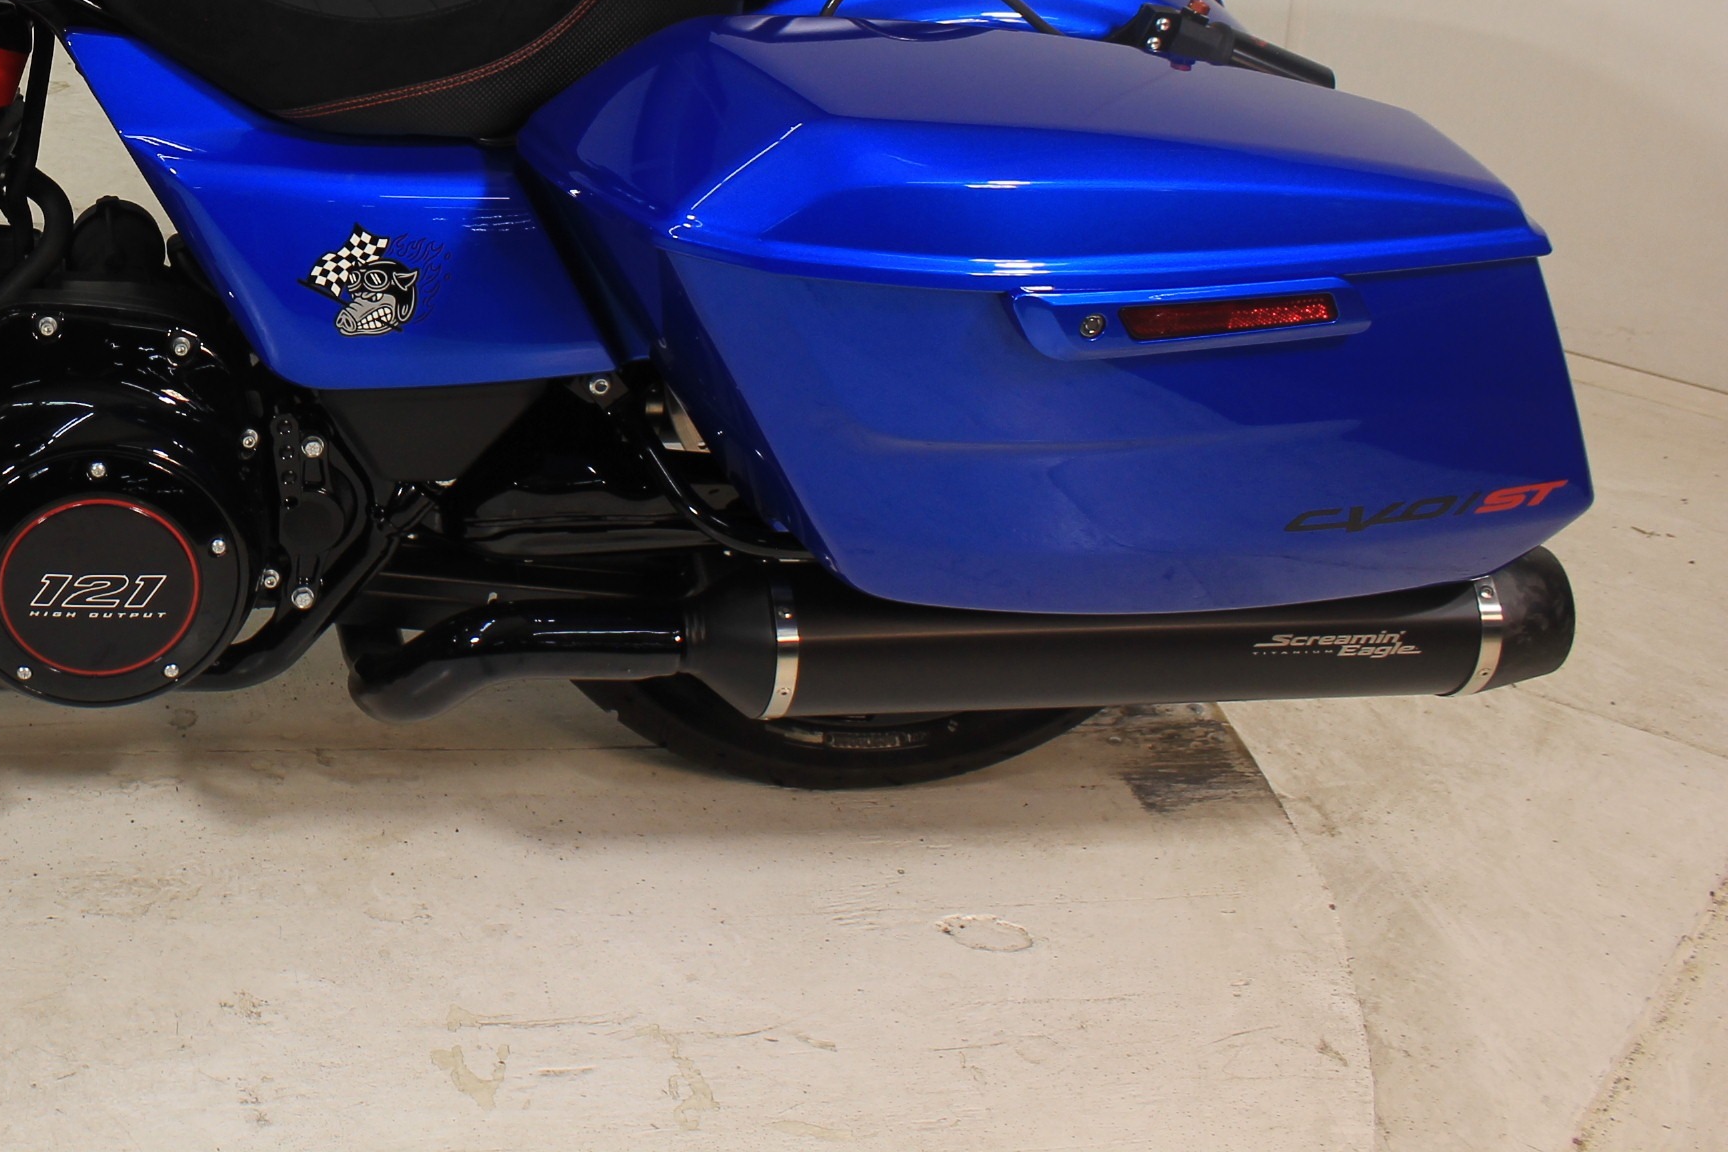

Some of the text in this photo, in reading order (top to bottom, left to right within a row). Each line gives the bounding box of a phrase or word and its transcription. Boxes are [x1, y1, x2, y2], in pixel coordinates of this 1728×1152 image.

[30, 573, 167, 608] 121
[29, 610, 167, 619] HIGH OUTPUT
[1253, 630, 1407, 648] Screamin'
[1337, 641, 1422, 659] Eagle
